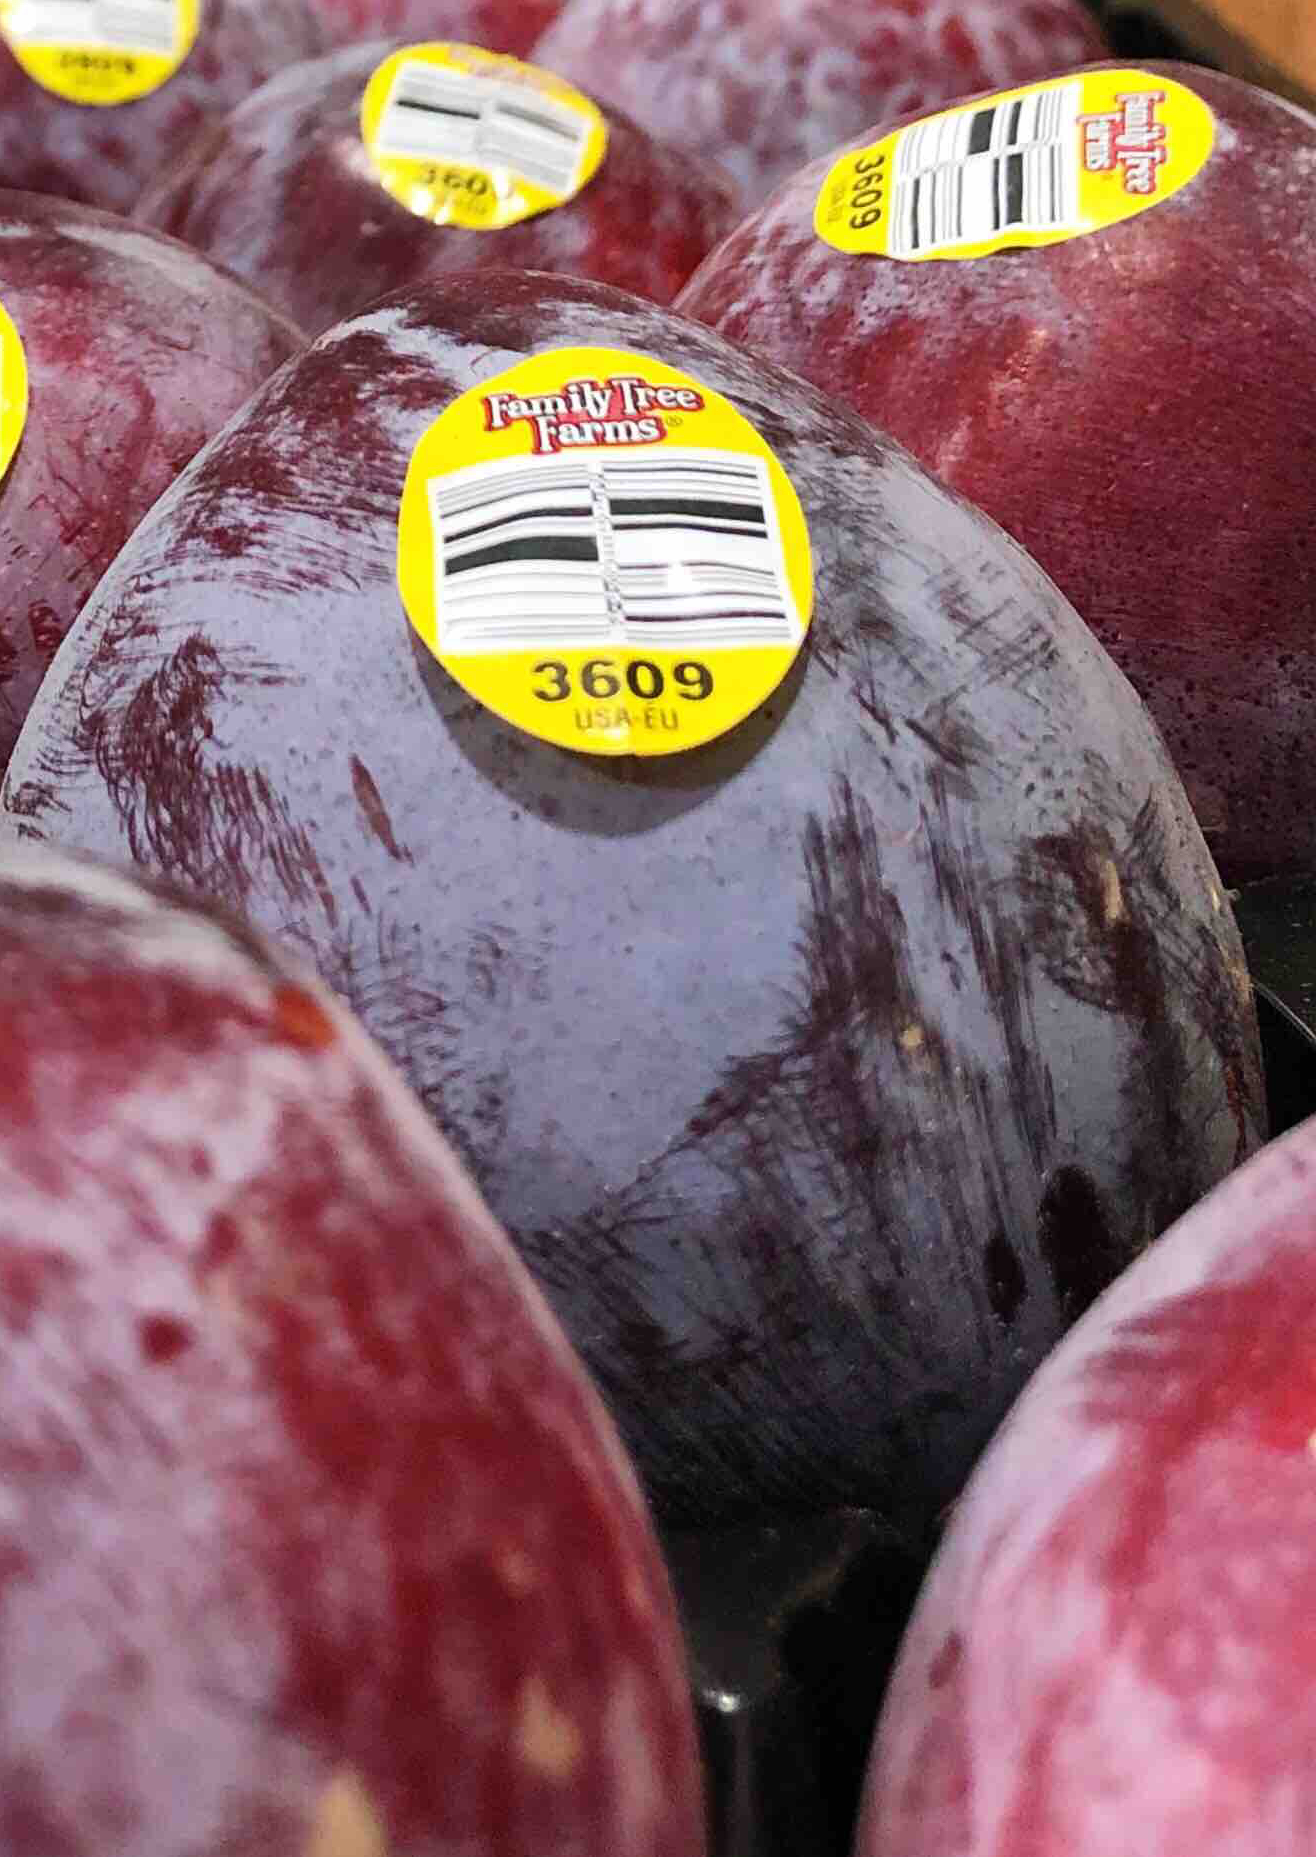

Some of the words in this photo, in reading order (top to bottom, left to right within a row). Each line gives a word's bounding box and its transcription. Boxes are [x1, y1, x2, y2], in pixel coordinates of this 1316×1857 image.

[850, 155, 885, 230] 3609
[484, 380, 614, 431] Family
[607, 377, 704, 416] Tree
[534, 413, 665, 454] Farms
[532, 660, 715, 702] 3609
[574, 709, 679, 730] USA-EU
